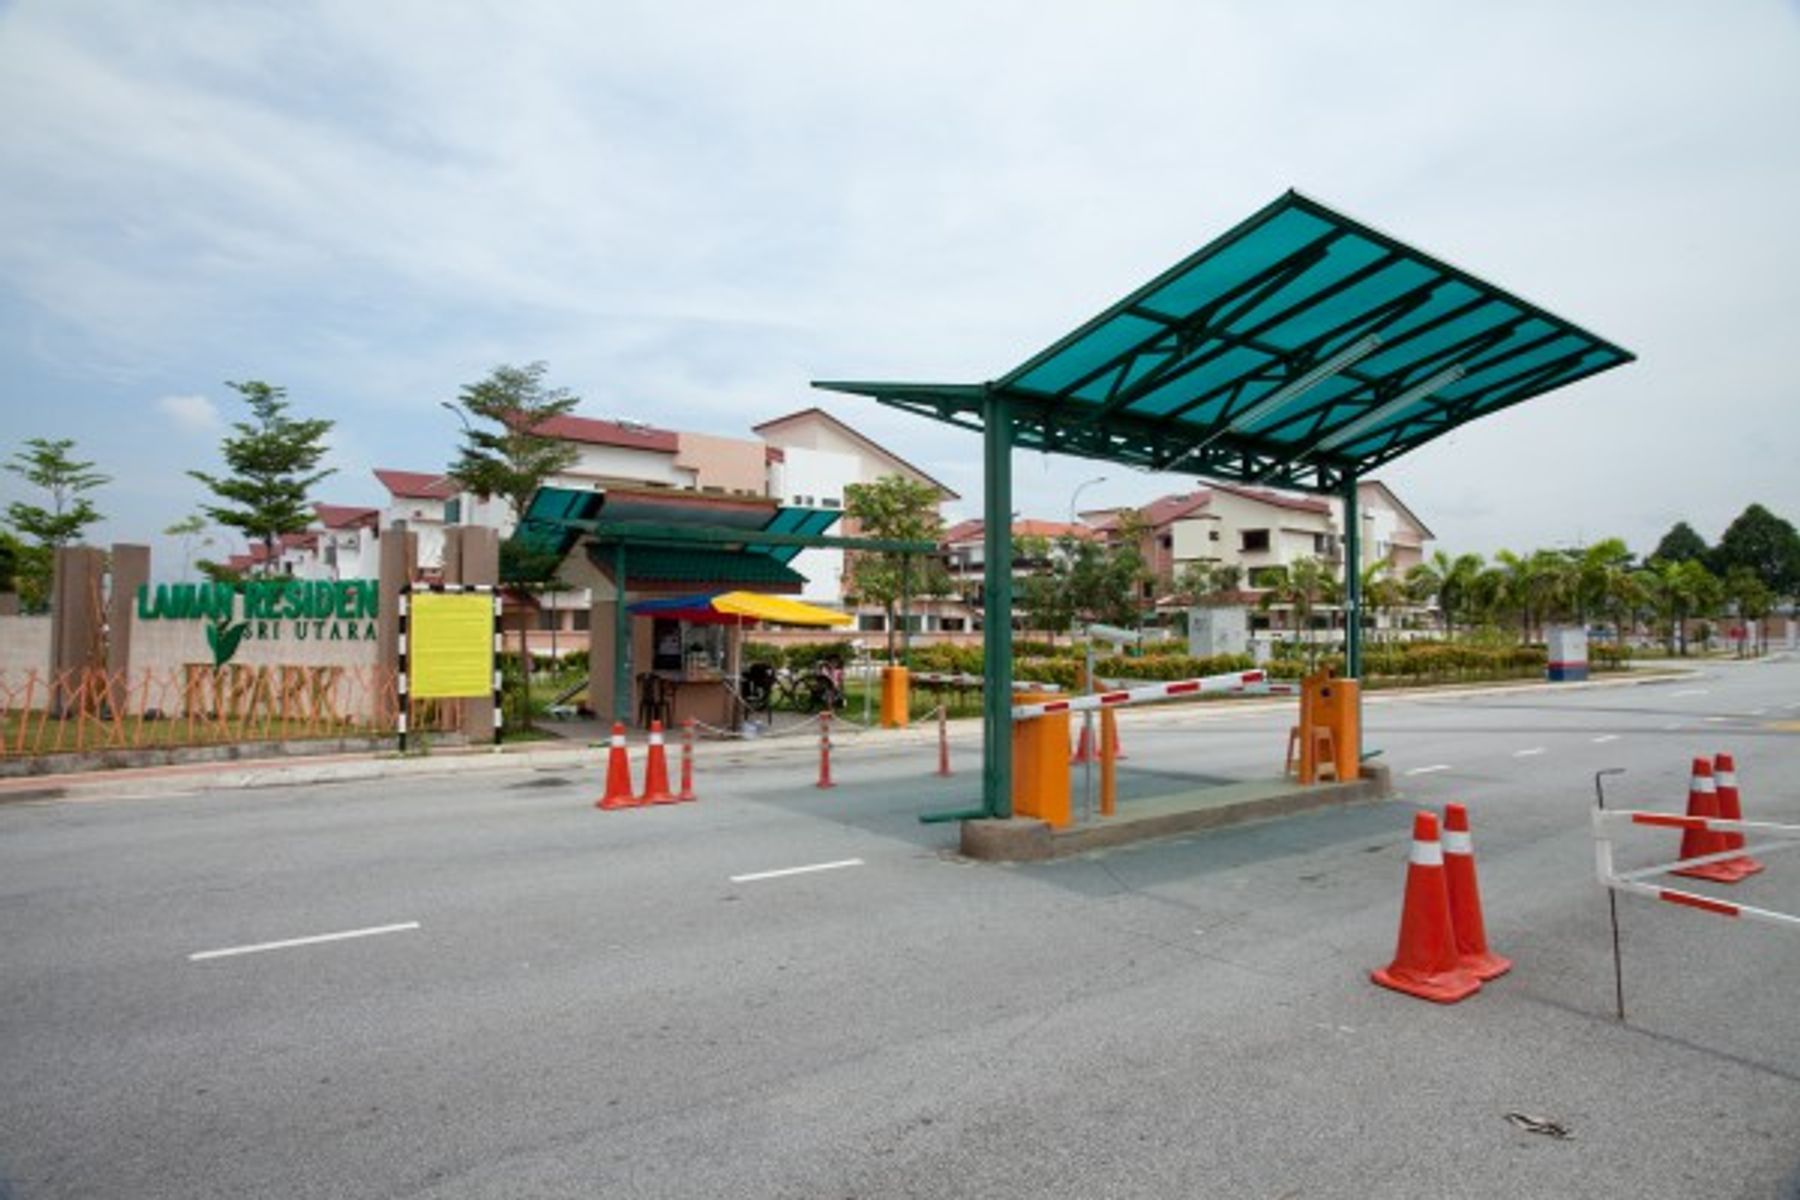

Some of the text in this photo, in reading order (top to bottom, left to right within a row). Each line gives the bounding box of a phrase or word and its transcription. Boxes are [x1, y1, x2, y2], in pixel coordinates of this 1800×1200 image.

[137, 579, 379, 620] LAMAN RESIDEN
[242, 621, 377, 640] SRI UTARA
